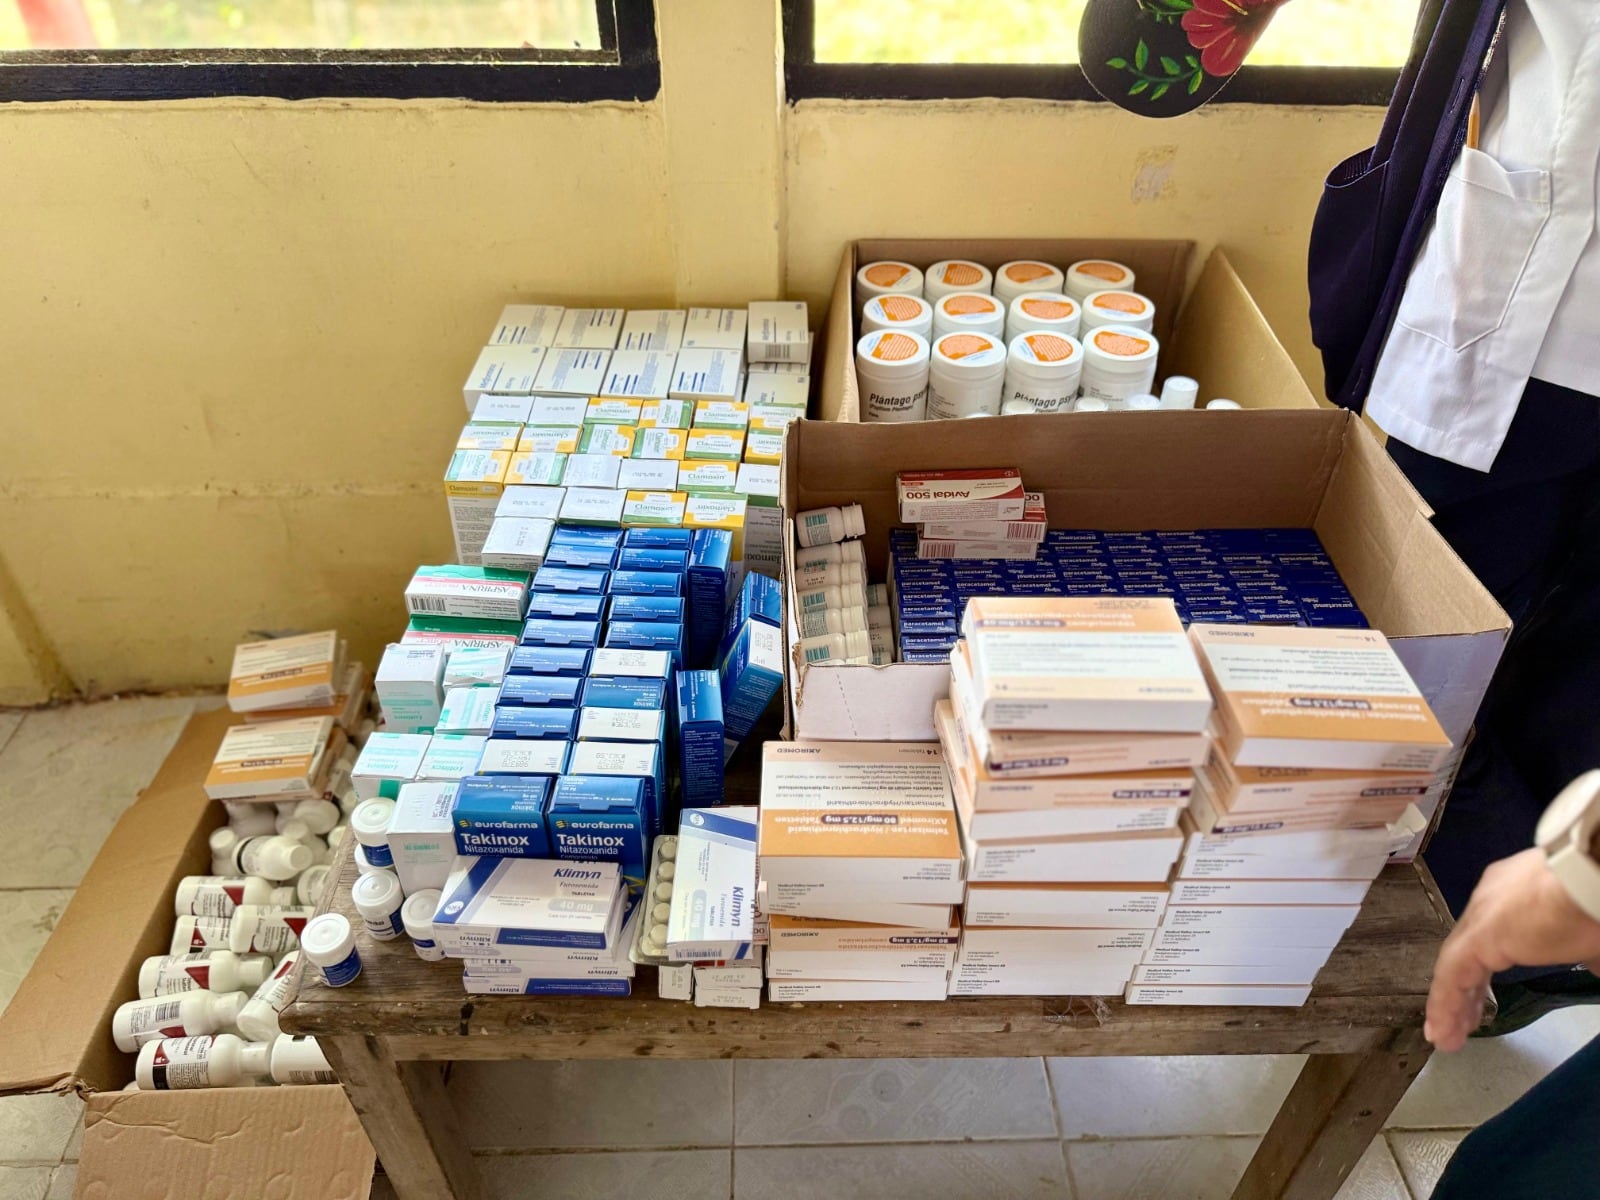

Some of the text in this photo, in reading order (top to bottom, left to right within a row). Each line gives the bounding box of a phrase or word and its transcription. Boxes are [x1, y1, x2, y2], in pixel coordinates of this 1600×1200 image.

[687, 473, 726, 481] Clamoxin
[933, 490, 970, 499] Avidal
[634, 503, 673, 511] Clamoxin
[462, 584, 511, 593] ASPIRINA
[454, 640, 505, 649] ASPIRINA
[774, 815, 820, 824] Tabletten
[825, 814, 841, 823] mg
[885, 816, 897, 824] 80
[475, 821, 538, 829] eurofarma
[571, 821, 634, 830] eurofarma
[788, 824, 884, 834] Hydrochlorothiazid
[890, 826, 949, 835] Telmisartan
[460, 833, 530, 846] Takinox
[556, 833, 625, 847] Takinox
[464, 845, 525, 854] Nitazoxanida
[559, 845, 619, 855] Nitazoxanida
[553, 868, 602, 880] Klimyn
[559, 881, 600, 890] Furosemida
[559, 902, 593, 912] 40 mg
[730, 886, 744, 927] Klimyn
